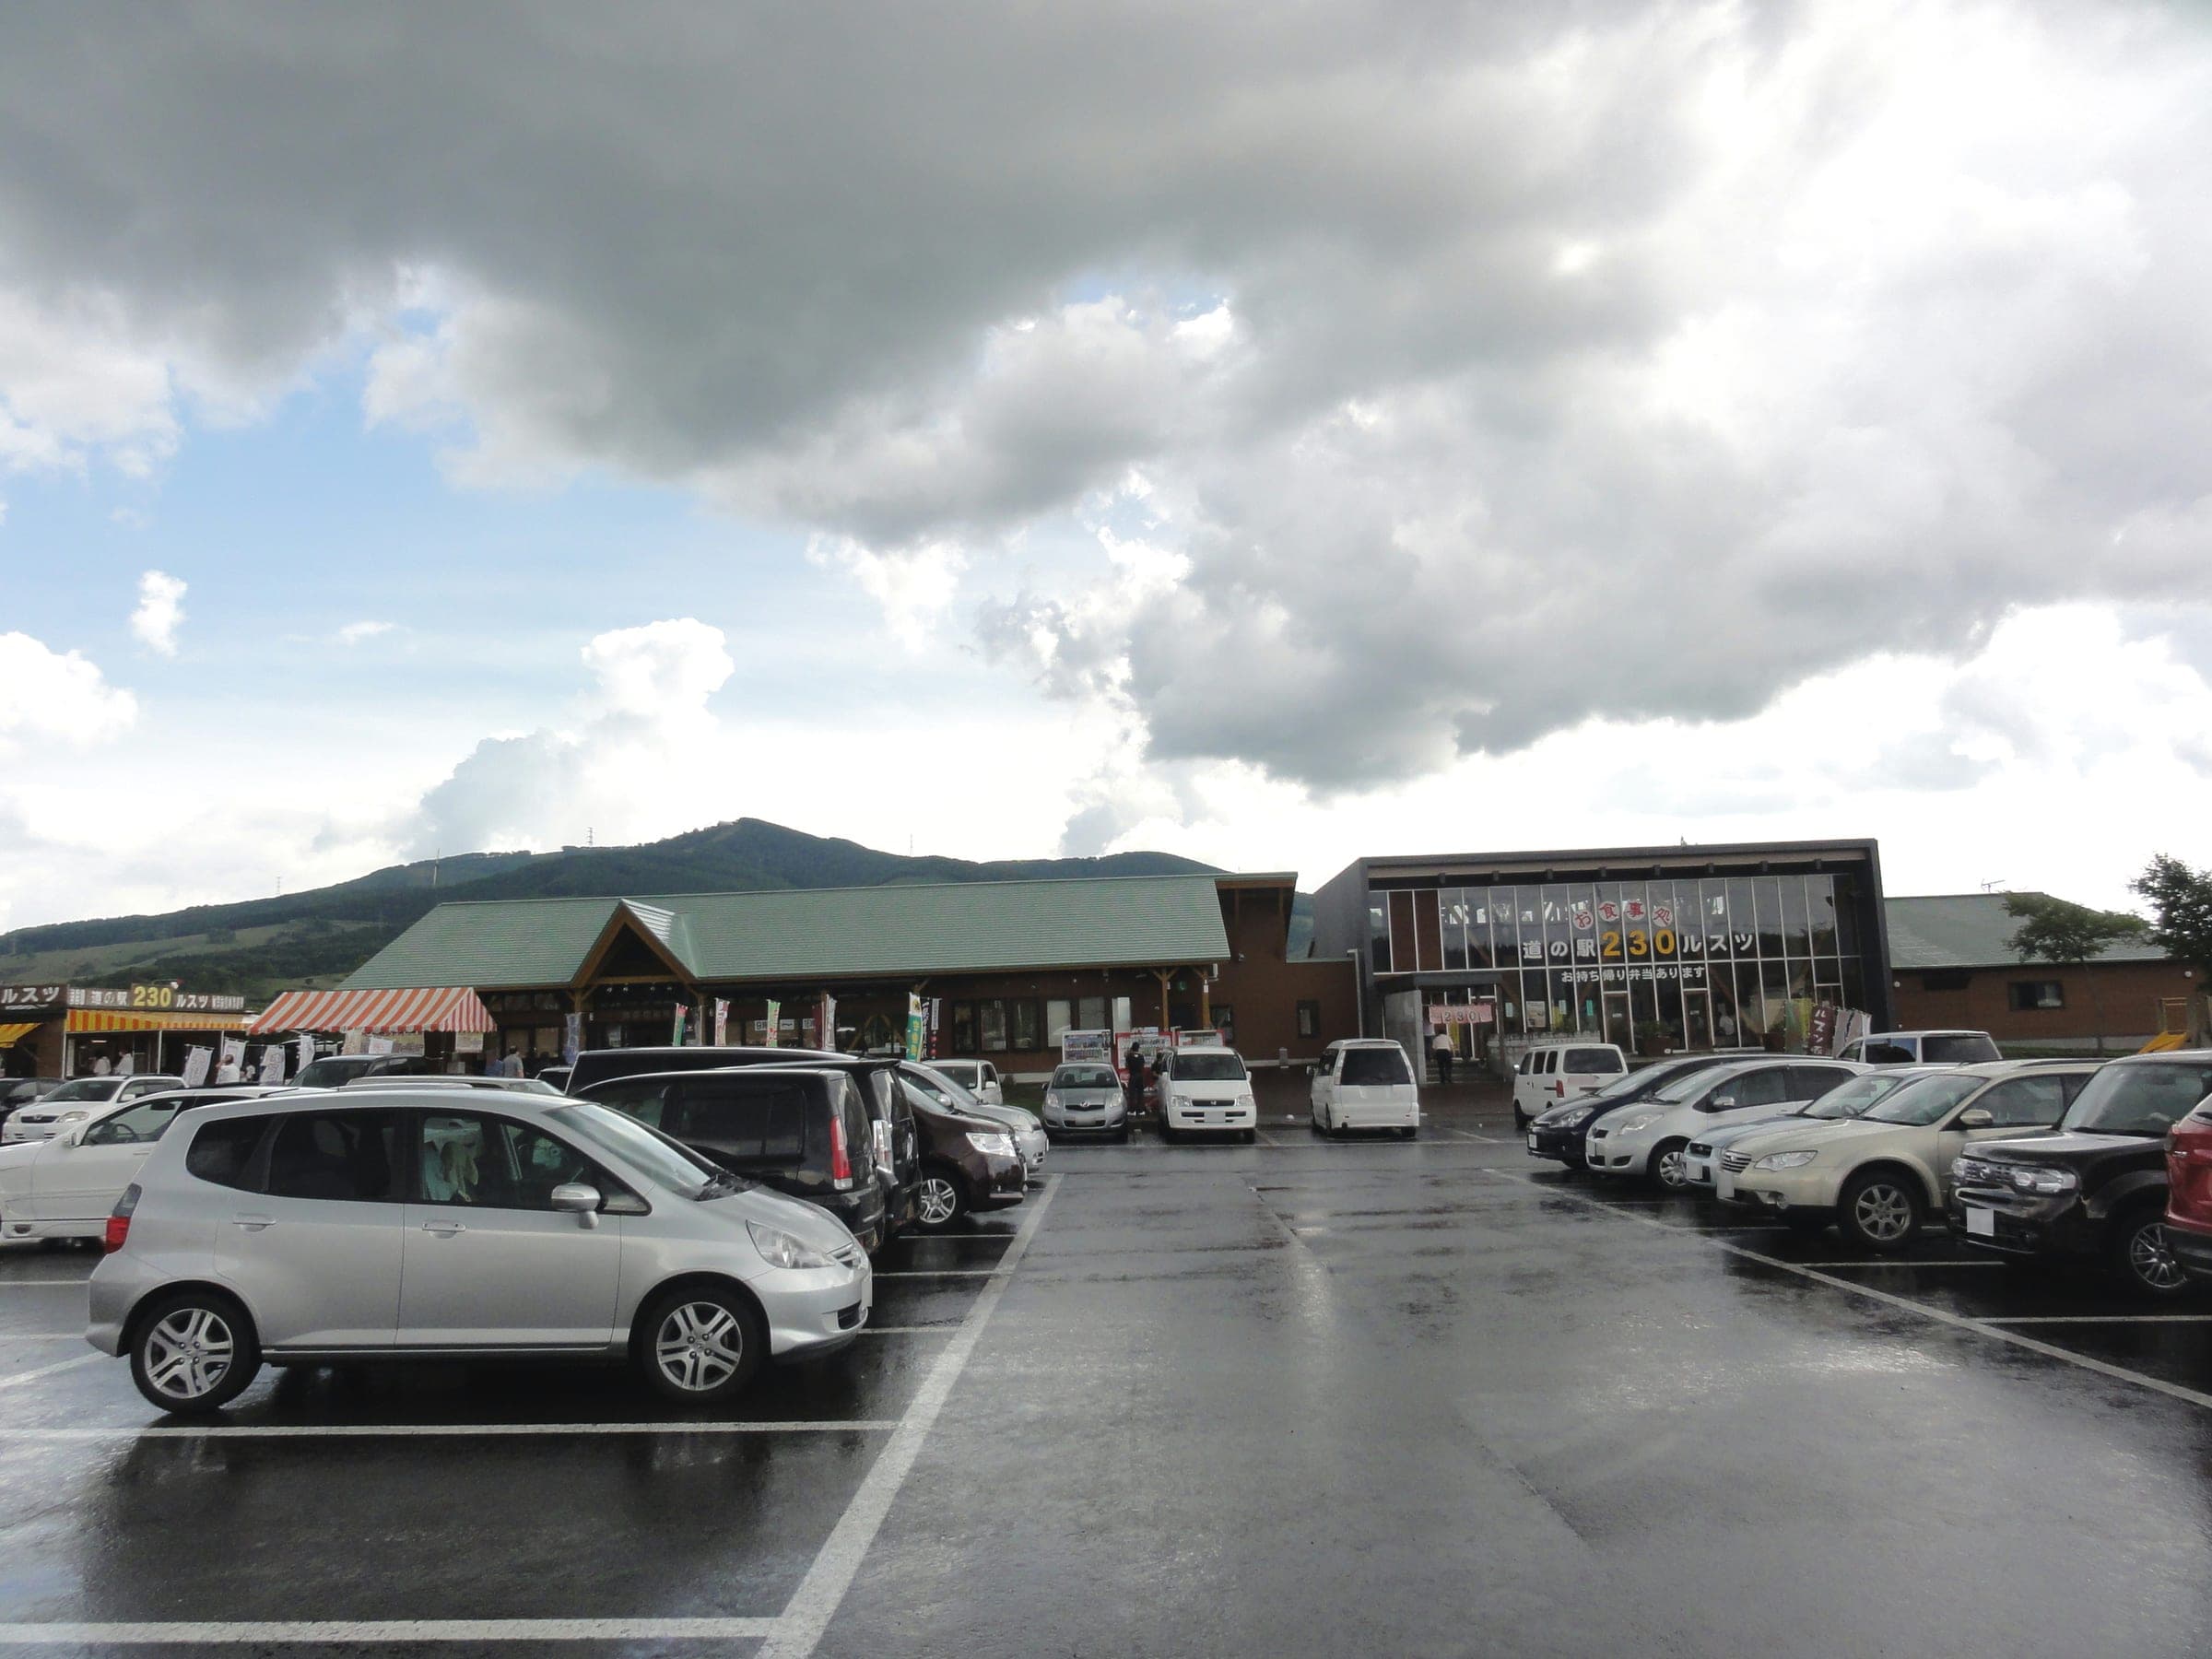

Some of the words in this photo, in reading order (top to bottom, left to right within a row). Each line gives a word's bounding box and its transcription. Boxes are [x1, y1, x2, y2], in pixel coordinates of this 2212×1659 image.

[1573, 901, 1672, 929] お食事処
[1523, 929, 1753, 959] 道の駅230ルスツ
[1561, 966, 1705, 982] お持ち帰り弁当あります
[1, 986, 60, 1004] ルスツ
[1444, 1010, 1477, 1022] 230
